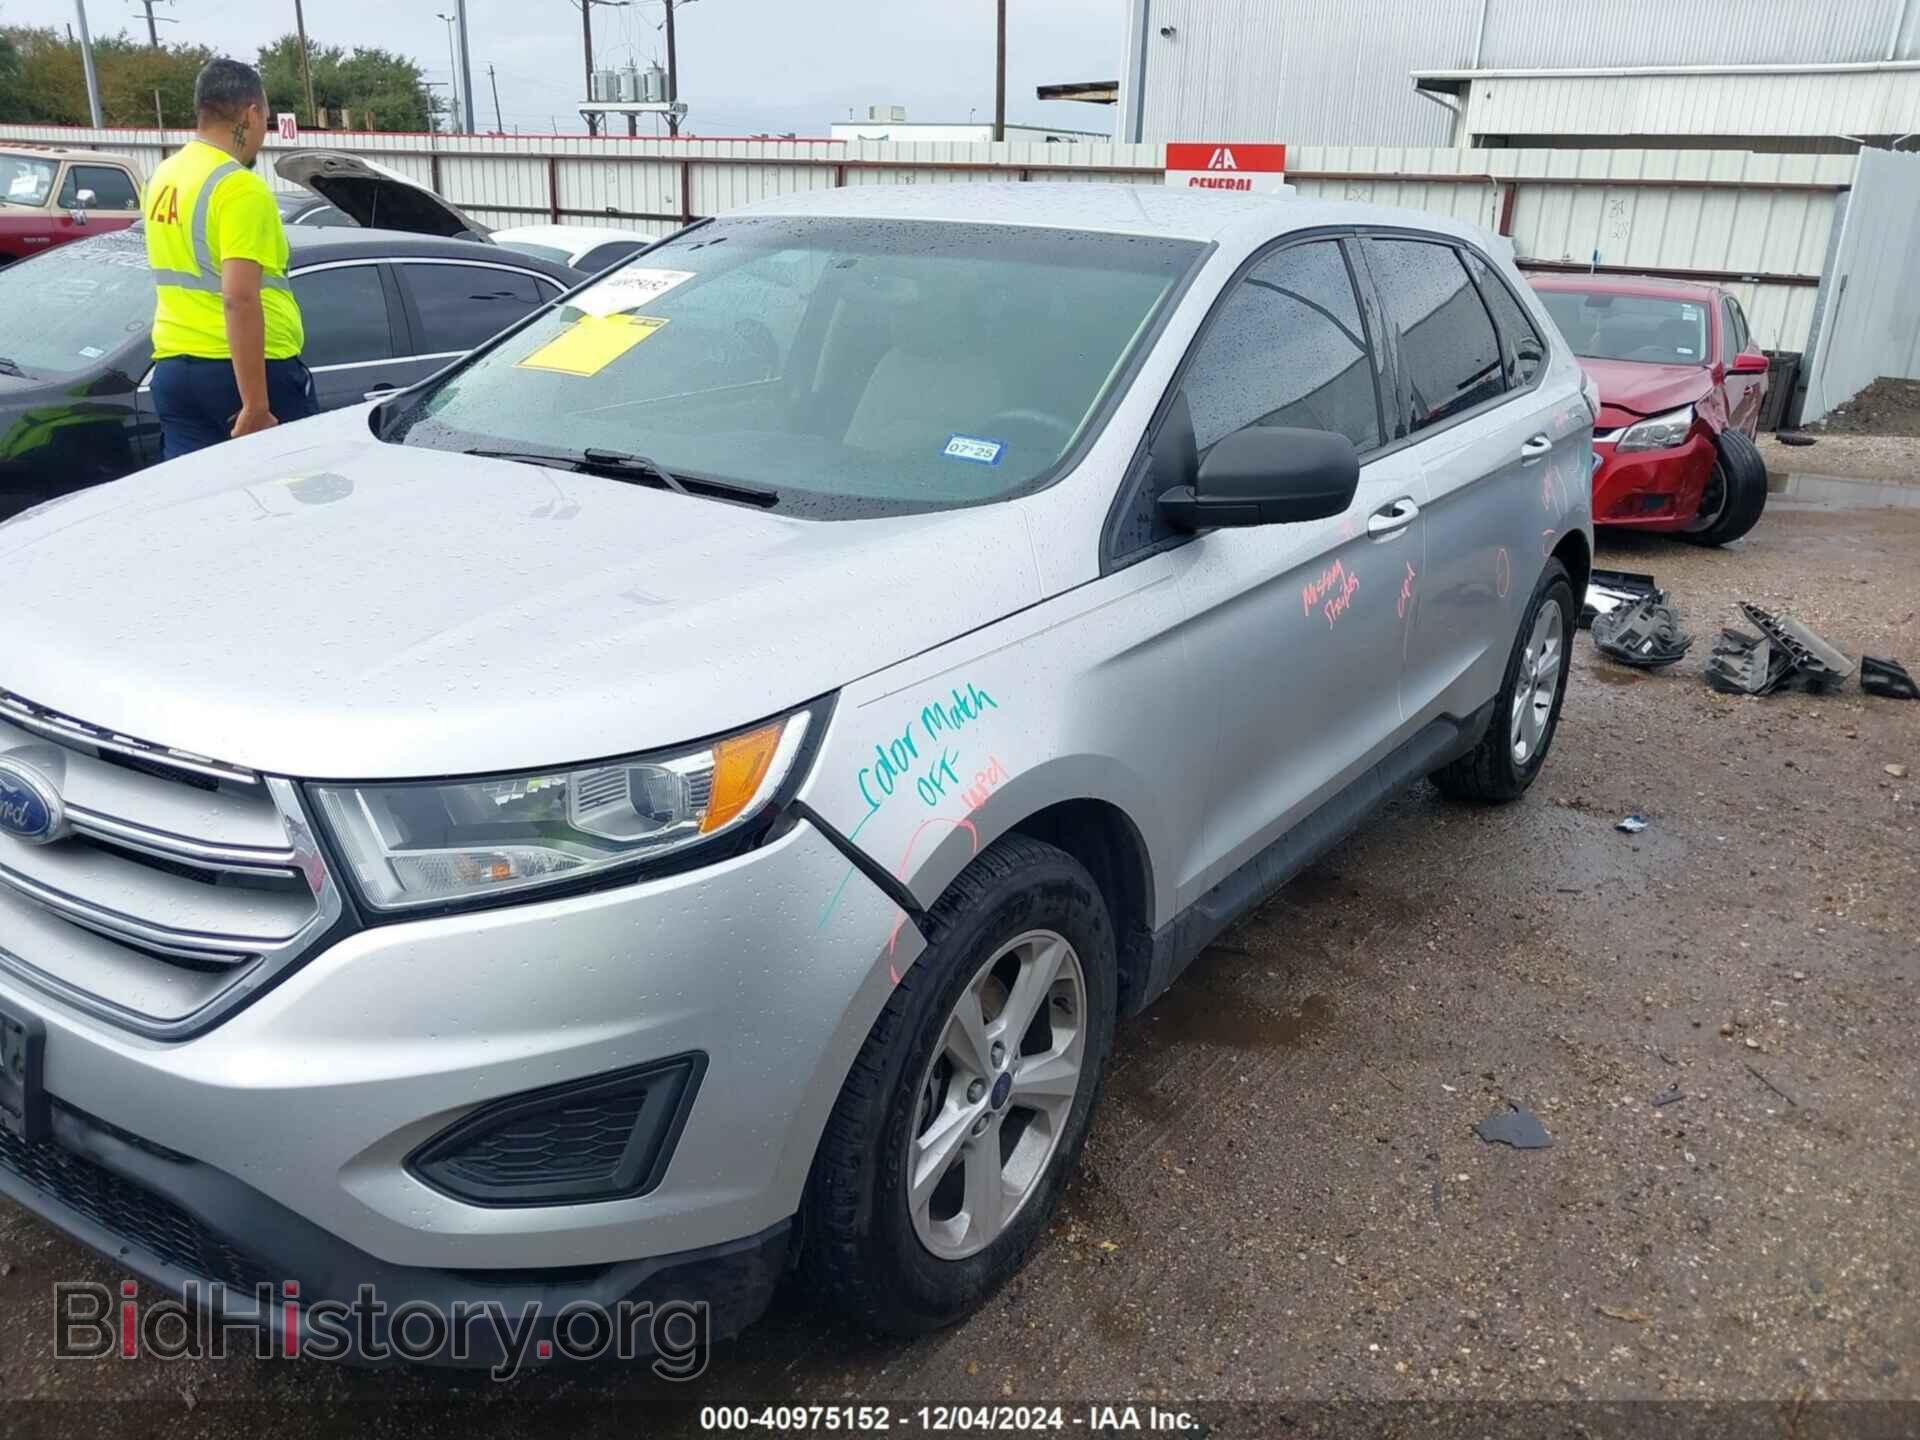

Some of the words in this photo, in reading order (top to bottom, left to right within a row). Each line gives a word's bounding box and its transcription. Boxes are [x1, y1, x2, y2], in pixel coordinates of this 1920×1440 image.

[280, 118, 295, 139] 20
[858, 721, 919, 808] Color
[921, 682, 999, 741] Match
